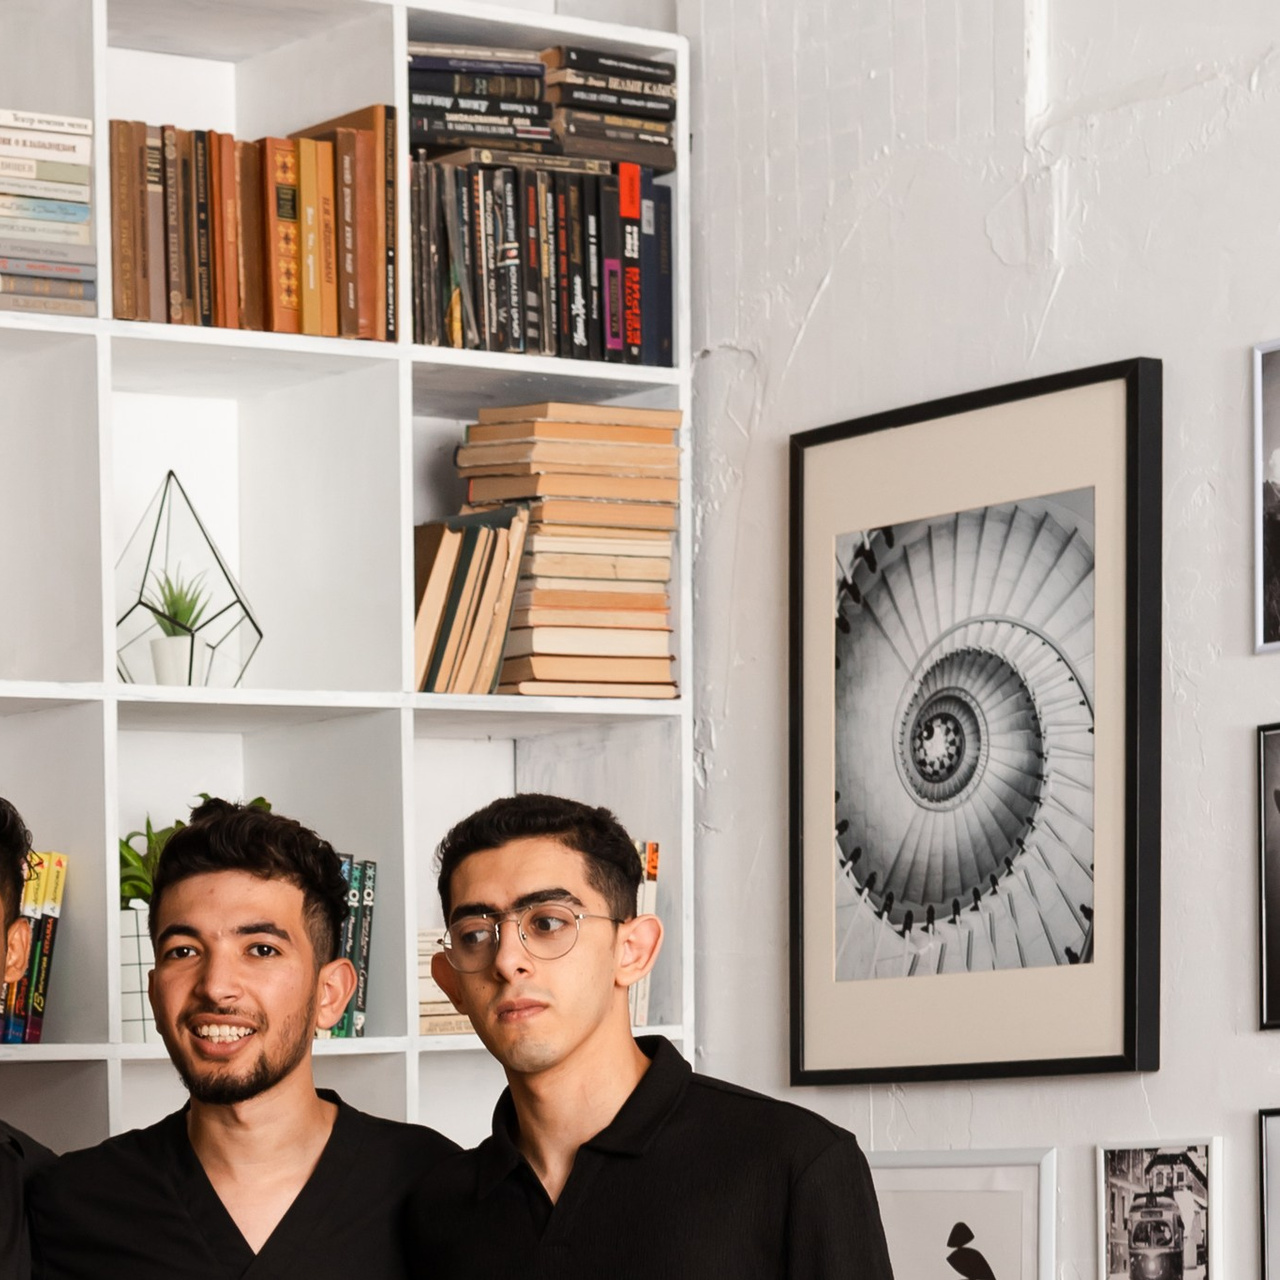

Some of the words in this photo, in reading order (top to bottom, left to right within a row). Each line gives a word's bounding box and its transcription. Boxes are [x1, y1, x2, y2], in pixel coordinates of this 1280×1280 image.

[168, 232, 180, 282] РОМЕН
[509, 265, 518, 307] ПЕТУХОВ
[509, 307, 521, 338] ЮРИЙ
